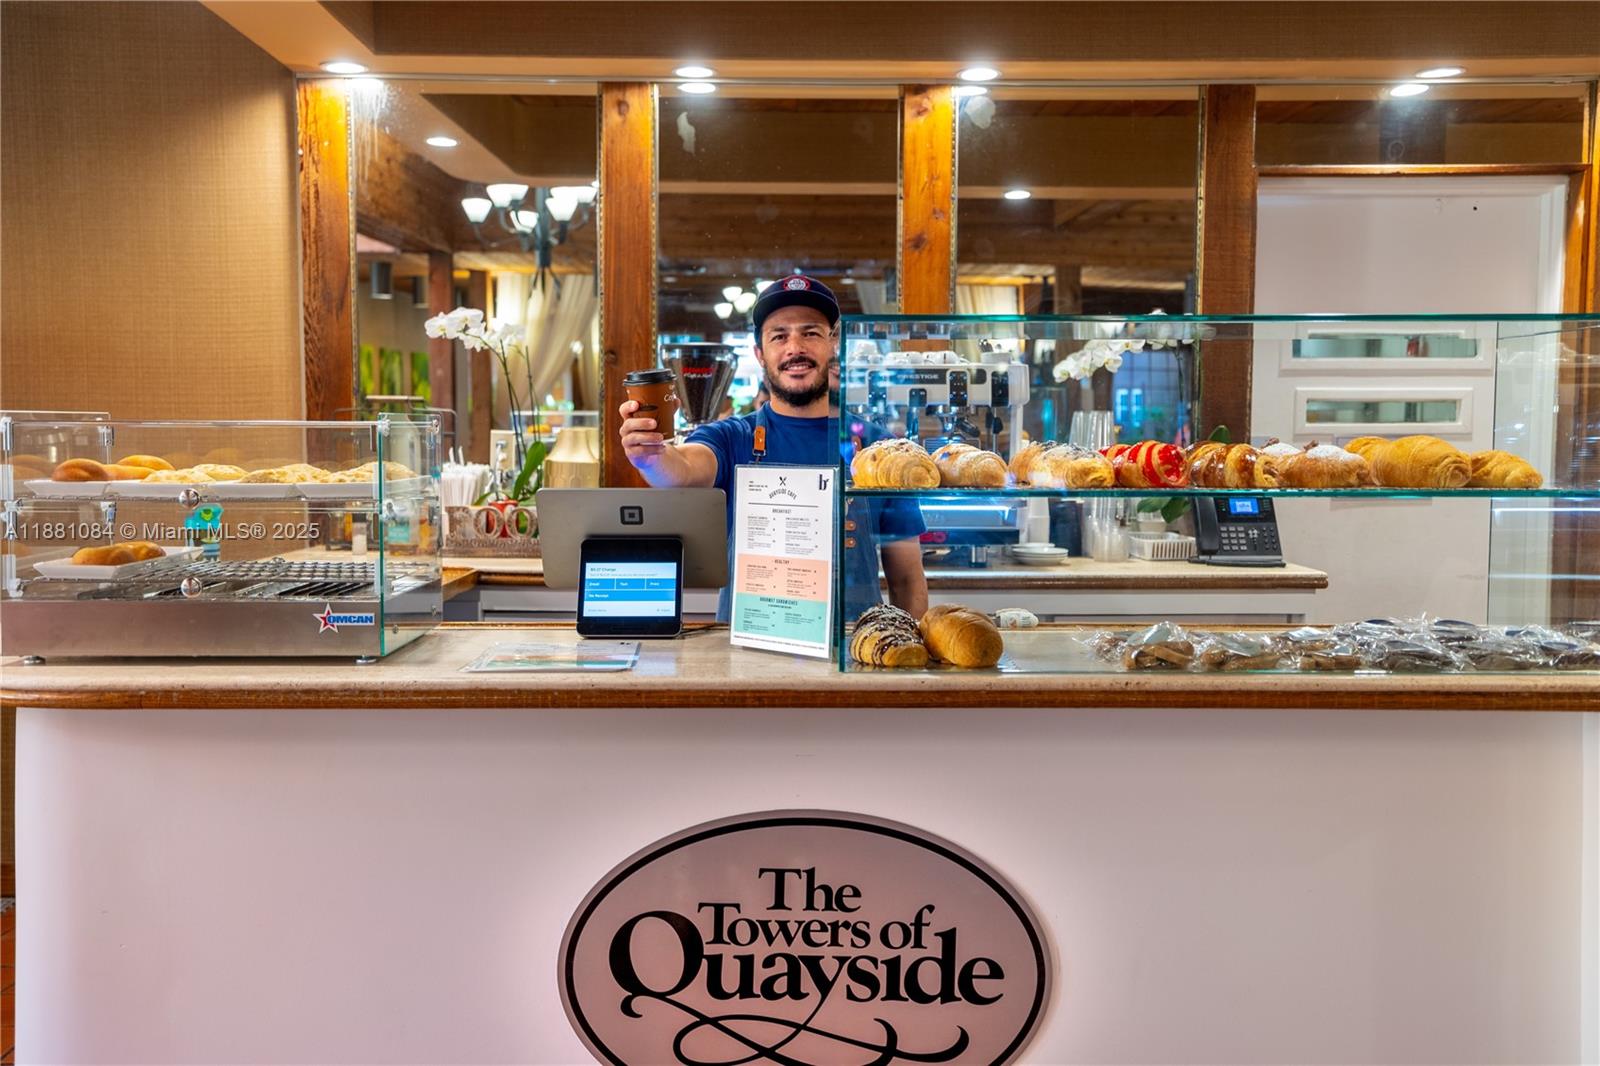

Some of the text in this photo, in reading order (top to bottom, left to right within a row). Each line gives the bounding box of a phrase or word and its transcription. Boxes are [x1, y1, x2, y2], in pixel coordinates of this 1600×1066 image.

[327, 615, 373, 624] OMCAN
[758, 867, 862, 912] The
[697, 902, 936, 950] Towers of
[608, 911, 1005, 1018] Quayside
